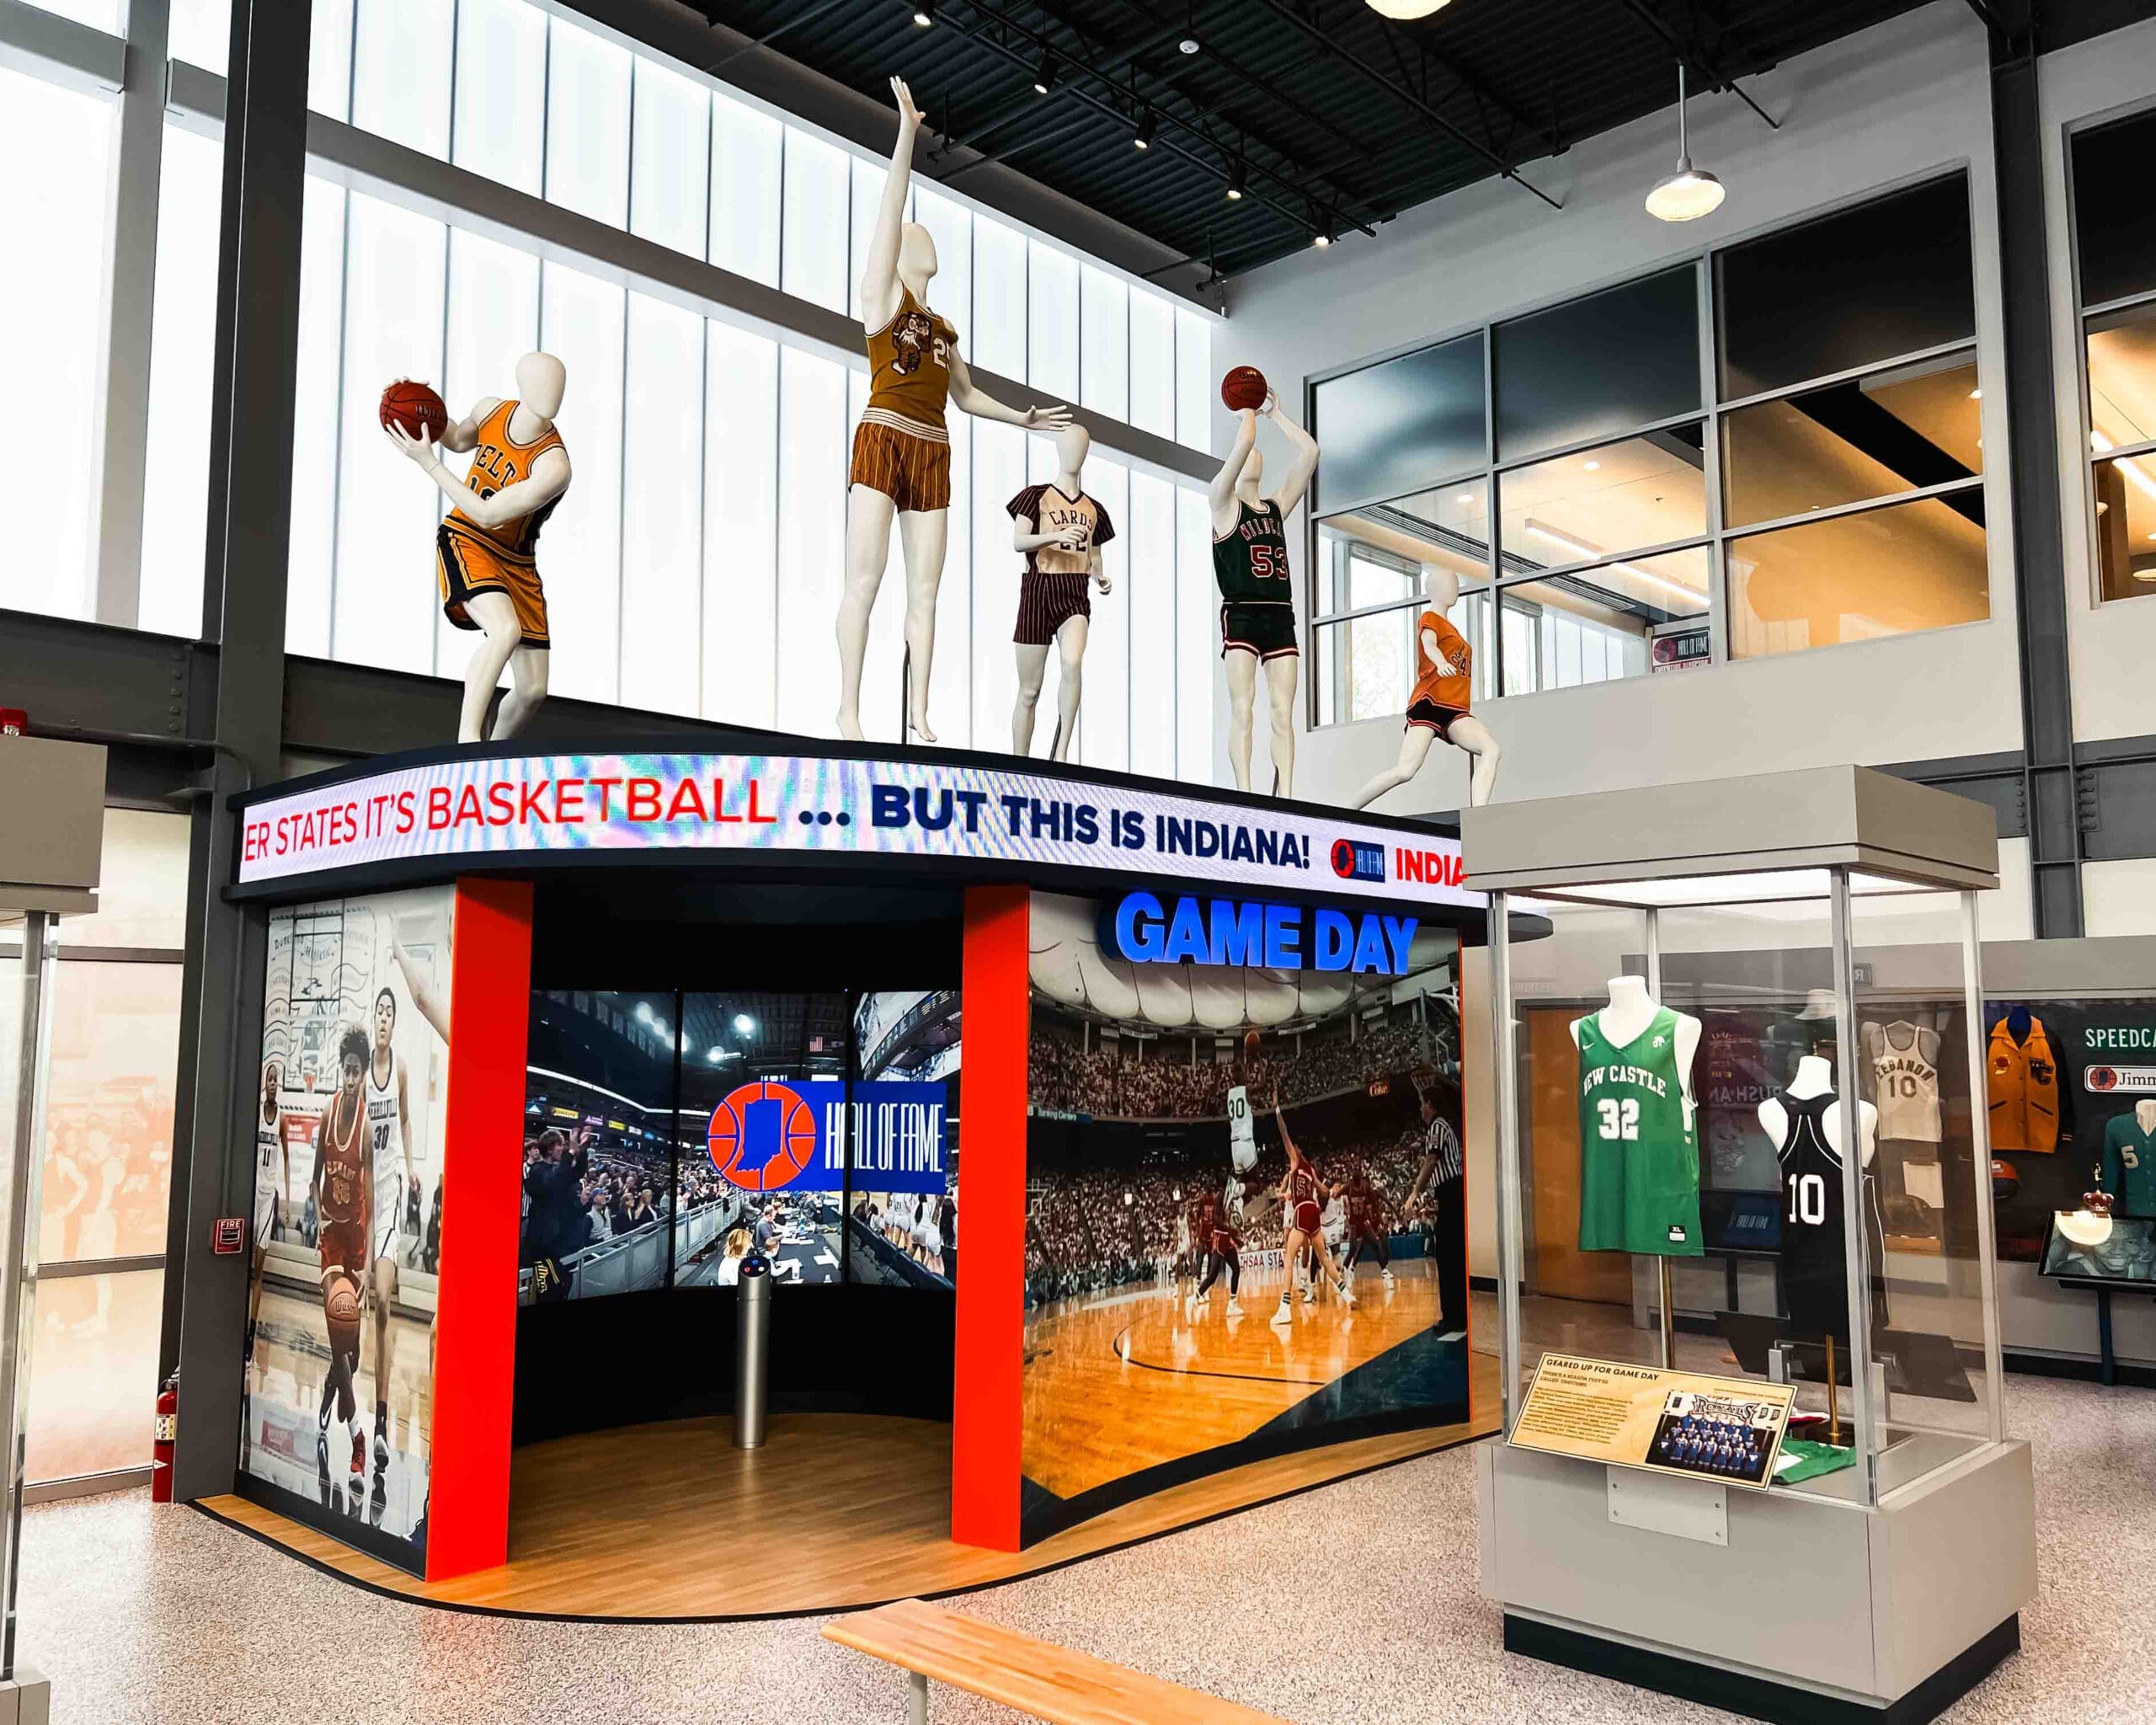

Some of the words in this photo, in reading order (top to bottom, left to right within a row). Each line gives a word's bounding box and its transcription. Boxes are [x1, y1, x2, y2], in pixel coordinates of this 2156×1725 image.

[1049, 510, 1093, 531] CARDS
[1250, 544, 1289, 580] 53
[244, 821, 270, 862] ER
[275, 802, 358, 856] STATES
[366, 795, 415, 839] IT'S
[427, 777, 778, 829] BASKETBALL
[871, 784, 988, 830] BUT
[1002, 796, 1100, 844] THIS
[1112, 810, 1146, 851] IS
[1156, 814, 1310, 870] INDIANA!
[1115, 891, 1302, 969] GAME
[1315, 909, 1419, 975] DAY
[1609, 1065, 1667, 1098] CASTLE
[1876, 1058, 1936, 1081] LEBANON
[1888, 1075, 1917, 1098] 10
[1597, 1097, 1641, 1141] 32
[373, 1124, 390, 1151] 30
[878, 1103, 899, 1172] OF
[900, 1103, 944, 1172] FAME
[2121, 1145, 2139, 1169] 5
[1788, 1173, 1825, 1226] 10
[1546, 1359, 1579, 1370] GEARED
[1593, 1365, 1611, 1375] FOR
[1613, 1368, 1639, 1379] GAME
[1641, 1372, 1659, 1381] DAY
